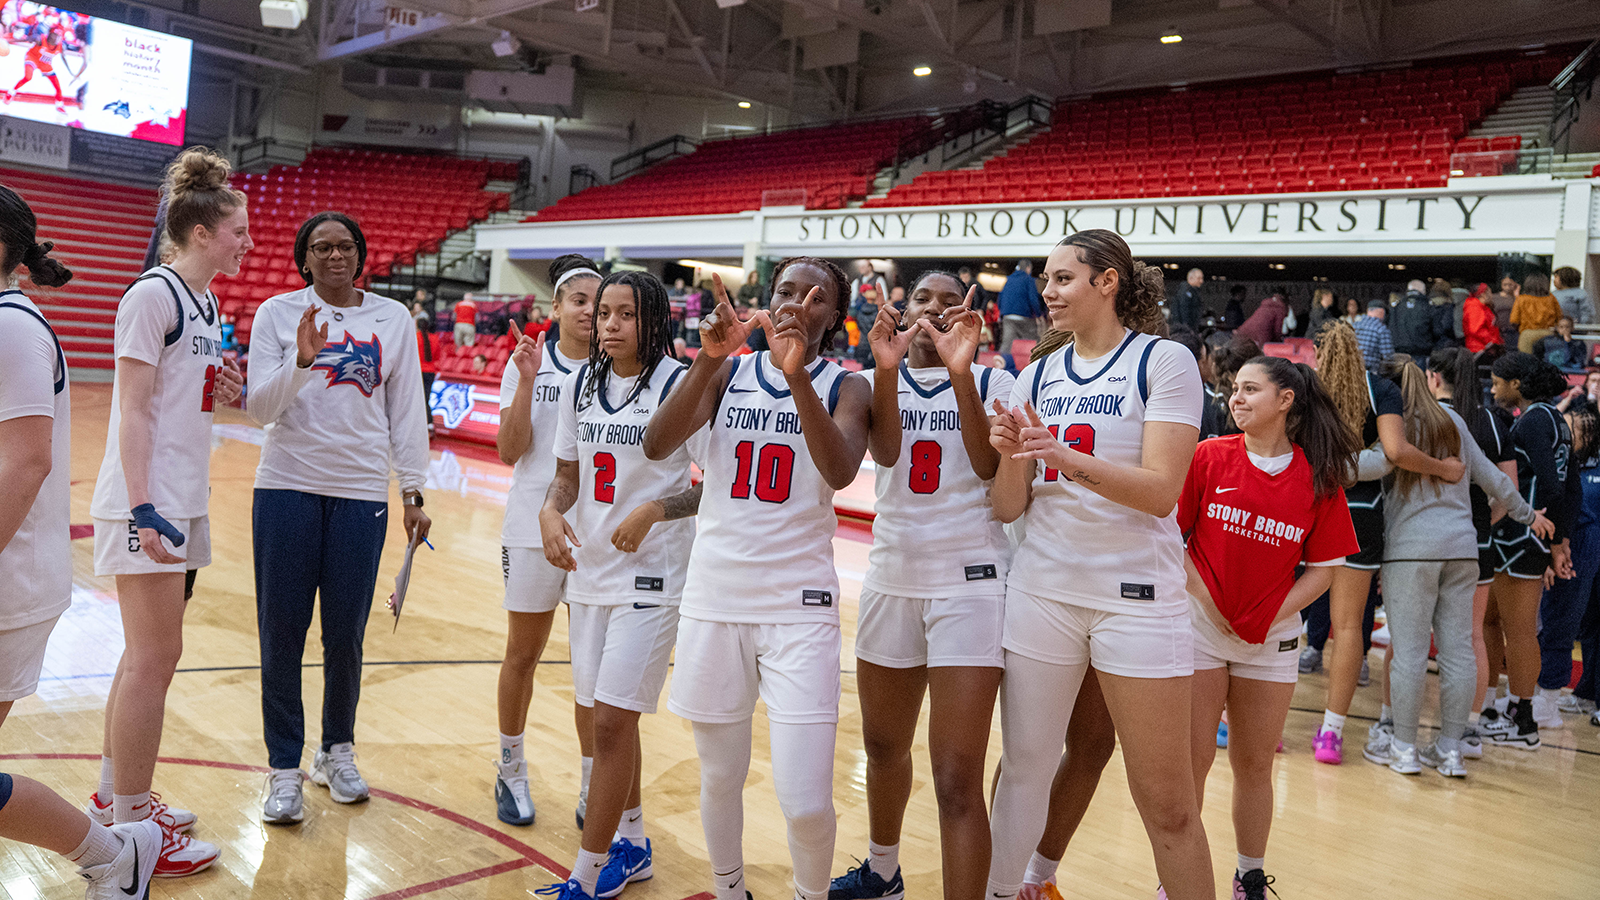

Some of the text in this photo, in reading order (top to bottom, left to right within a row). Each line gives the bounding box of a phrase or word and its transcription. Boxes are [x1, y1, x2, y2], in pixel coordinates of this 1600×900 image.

[124, 37, 161, 54] black
[123, 61, 161, 74] month
[798, 195, 1489, 241] STONY BROOK UNIVERSITY
[535, 385, 562, 402] STON
[1040, 393, 1126, 419] STONY BROOK
[725, 406, 803, 435] STONY BRO
[605, 423, 648, 447] BROOK
[593, 450, 617, 505] 2
[730, 440, 796, 505] 10
[908, 440, 942, 494] 8
[1206, 502, 1305, 544] STONY BROOK
[1222, 523, 1281, 547] BASKETBALL
